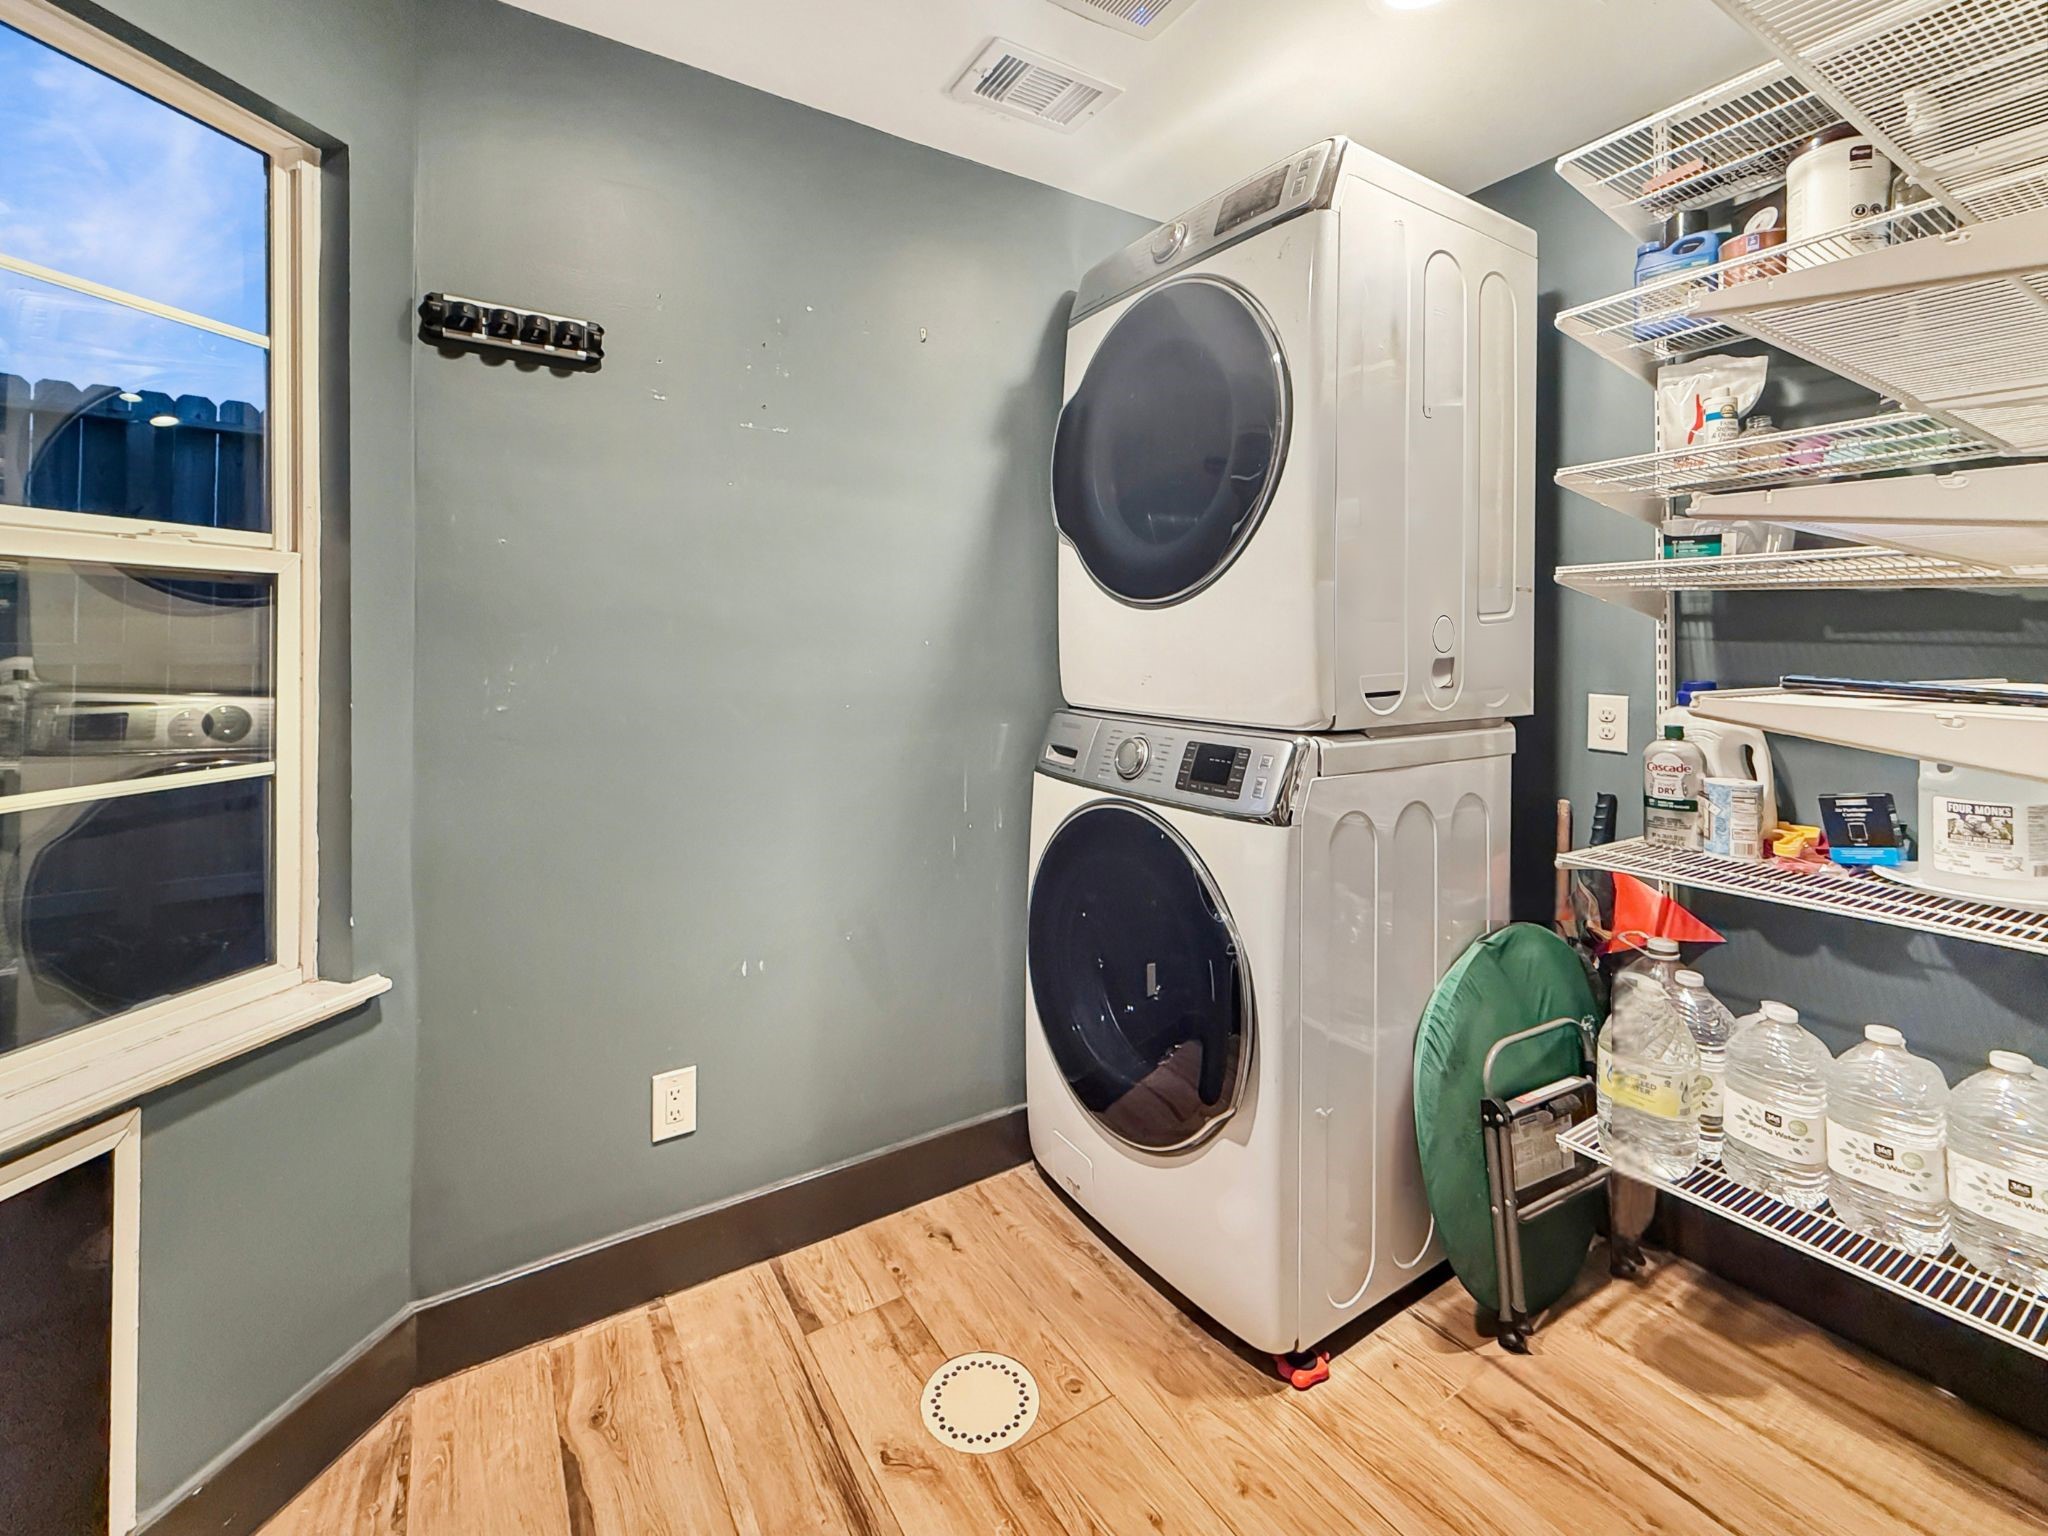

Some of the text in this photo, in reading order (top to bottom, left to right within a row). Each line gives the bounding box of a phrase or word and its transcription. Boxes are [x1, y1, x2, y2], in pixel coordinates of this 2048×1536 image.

[1646, 762, 1692, 774] Cascade
[1658, 787, 1677, 795] DRY
[1948, 803, 2012, 817] FOUR MONKS
[1749, 1119, 1800, 1142] Spring Water
[1856, 1153, 1916, 1177] Spring Water
[1986, 1189, 2021, 1208] Spring
